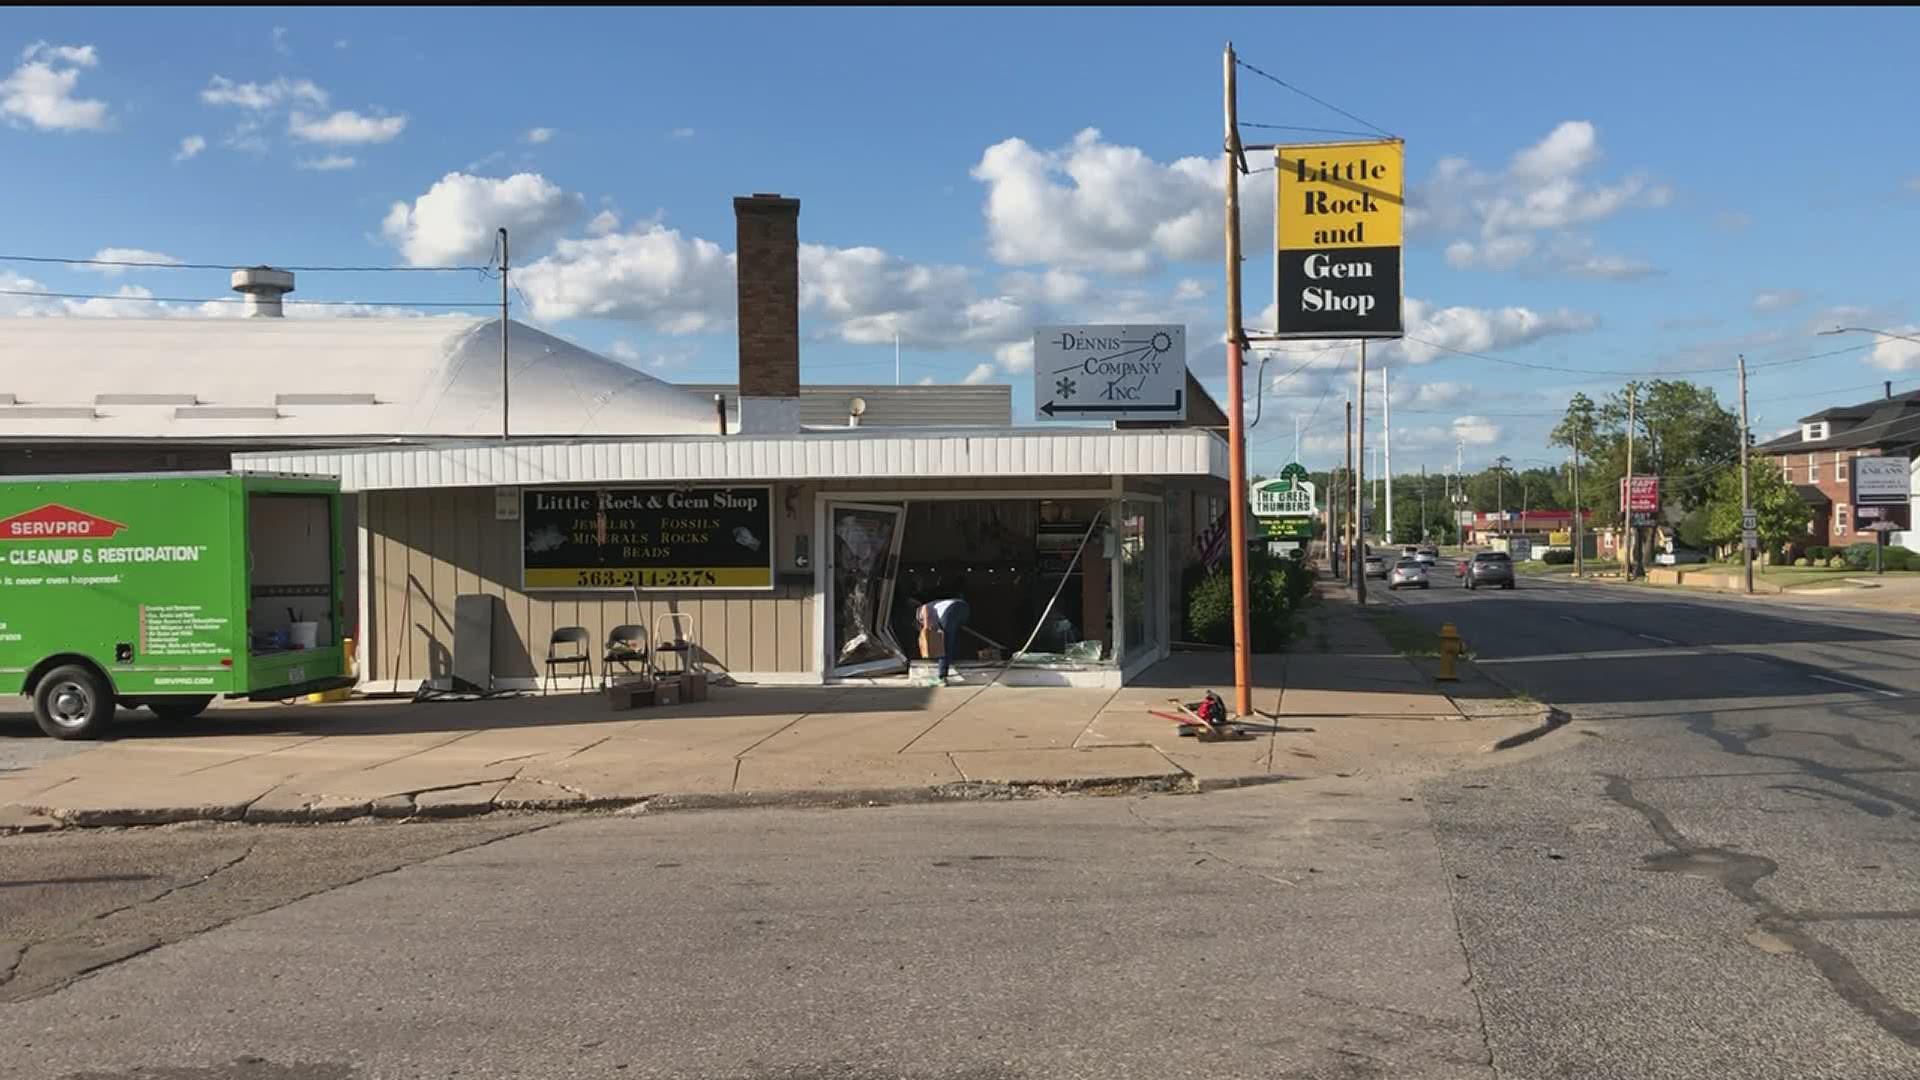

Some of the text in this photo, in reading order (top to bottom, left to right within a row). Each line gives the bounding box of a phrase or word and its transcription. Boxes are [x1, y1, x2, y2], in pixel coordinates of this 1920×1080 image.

[1297, 158, 1386, 183] Little
[1304, 191, 1379, 215] Rock
[1314, 222, 1364, 244] and
[1303, 253, 1373, 279] Gem
[1301, 286, 1375, 316] Shop
[1062, 332, 1120, 350] DENNIS
[1084, 357, 1161, 375] COMPANY
[537, 492, 758, 511] Little Rock & Gem Shop
[1257, 490, 1310, 502] THE GREEN
[1257, 502, 1311, 512] THUMBERS
[661, 518, 720, 529] FOSSILS
[661, 532, 709, 543] ROCKS
[9, 548, 79, 565] CLEANUP
[82, 548, 94, 564] &
[623, 546, 670, 558] BEADS
[16, 577, 42, 585] never
[46, 577, 69, 585] even
